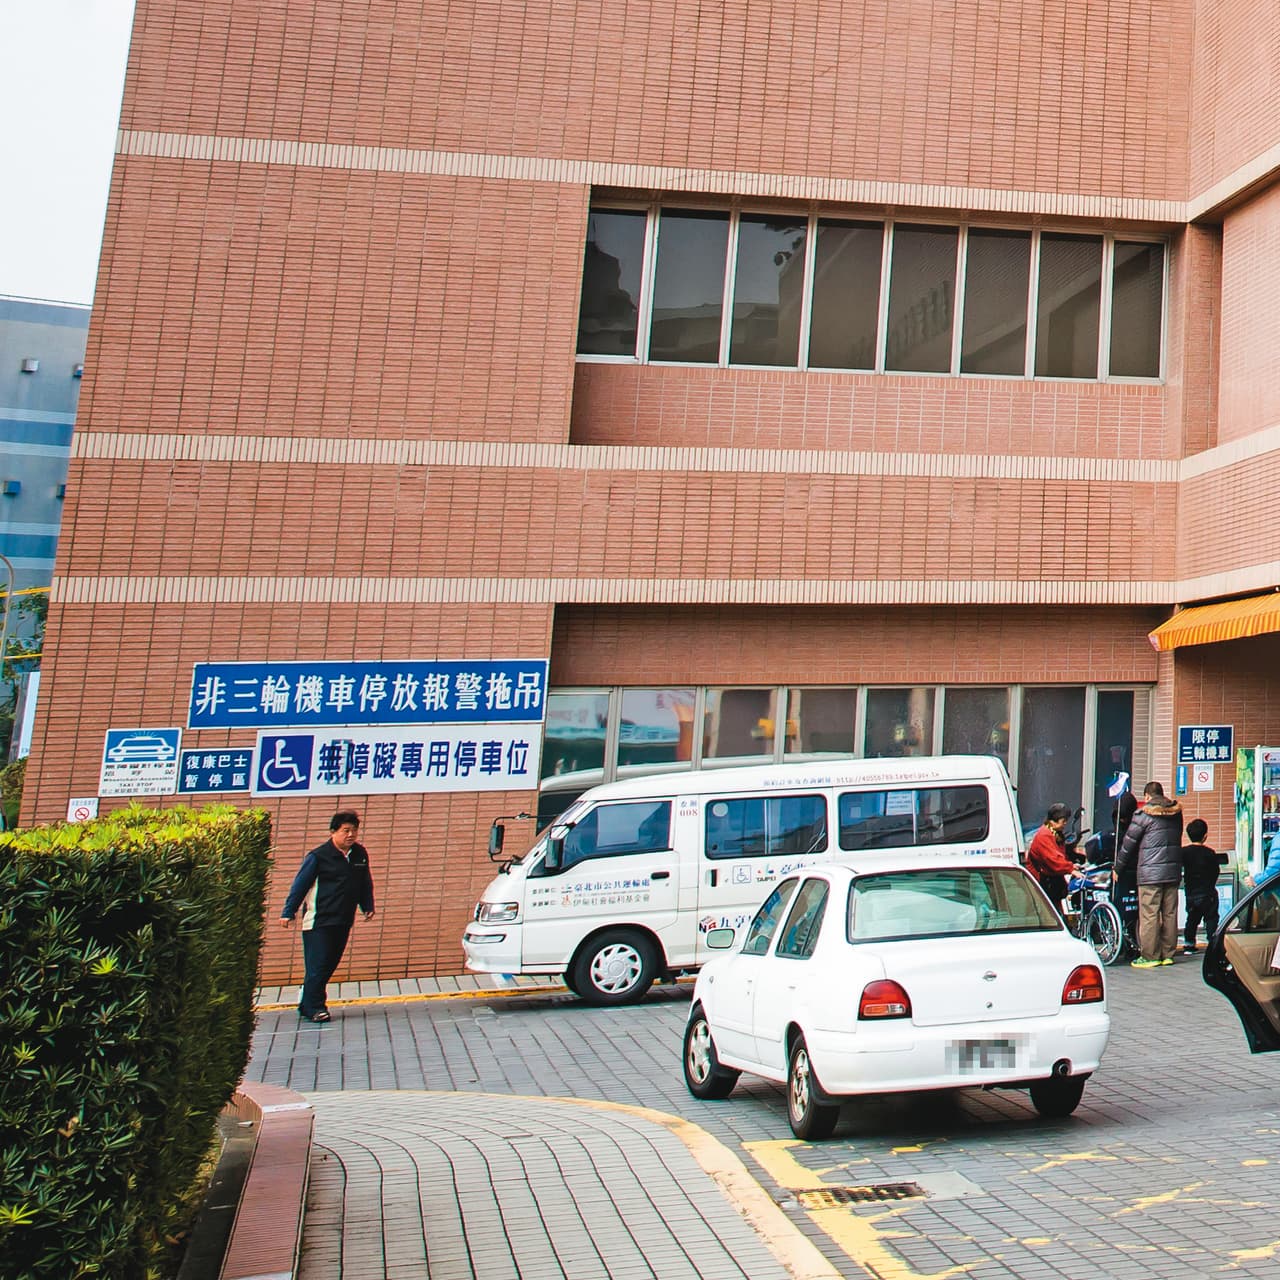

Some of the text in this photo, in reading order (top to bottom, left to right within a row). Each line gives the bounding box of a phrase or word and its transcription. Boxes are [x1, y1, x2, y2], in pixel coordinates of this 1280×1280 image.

[195, 671, 542, 716] 非三輪機車停放報警拖吊
[1191, 728, 1221, 744] 限停
[317, 738, 530, 784] 無障礙專用停車位
[1181, 745, 1230, 761] 三輪機車
[186, 754, 248, 770] 復康巴士
[185, 772, 247, 789] 暫停區
[680, 809, 698, 817] 008
